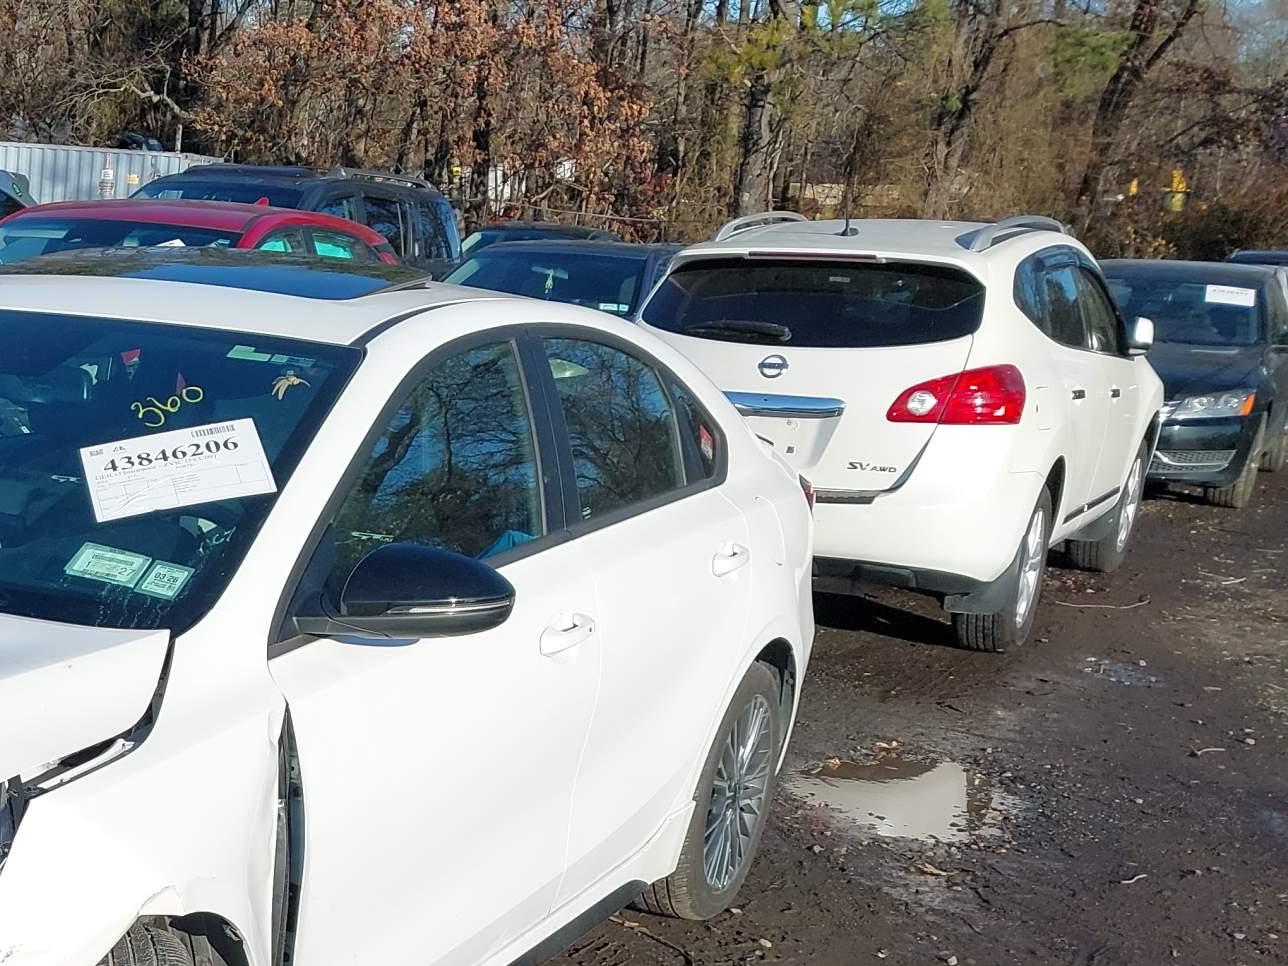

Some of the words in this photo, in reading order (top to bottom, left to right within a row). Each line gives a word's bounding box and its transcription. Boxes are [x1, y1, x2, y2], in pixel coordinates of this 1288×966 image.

[130, 386, 204, 427] 360
[103, 436, 240, 473] 43846206
[847, 461, 870, 471] SV
